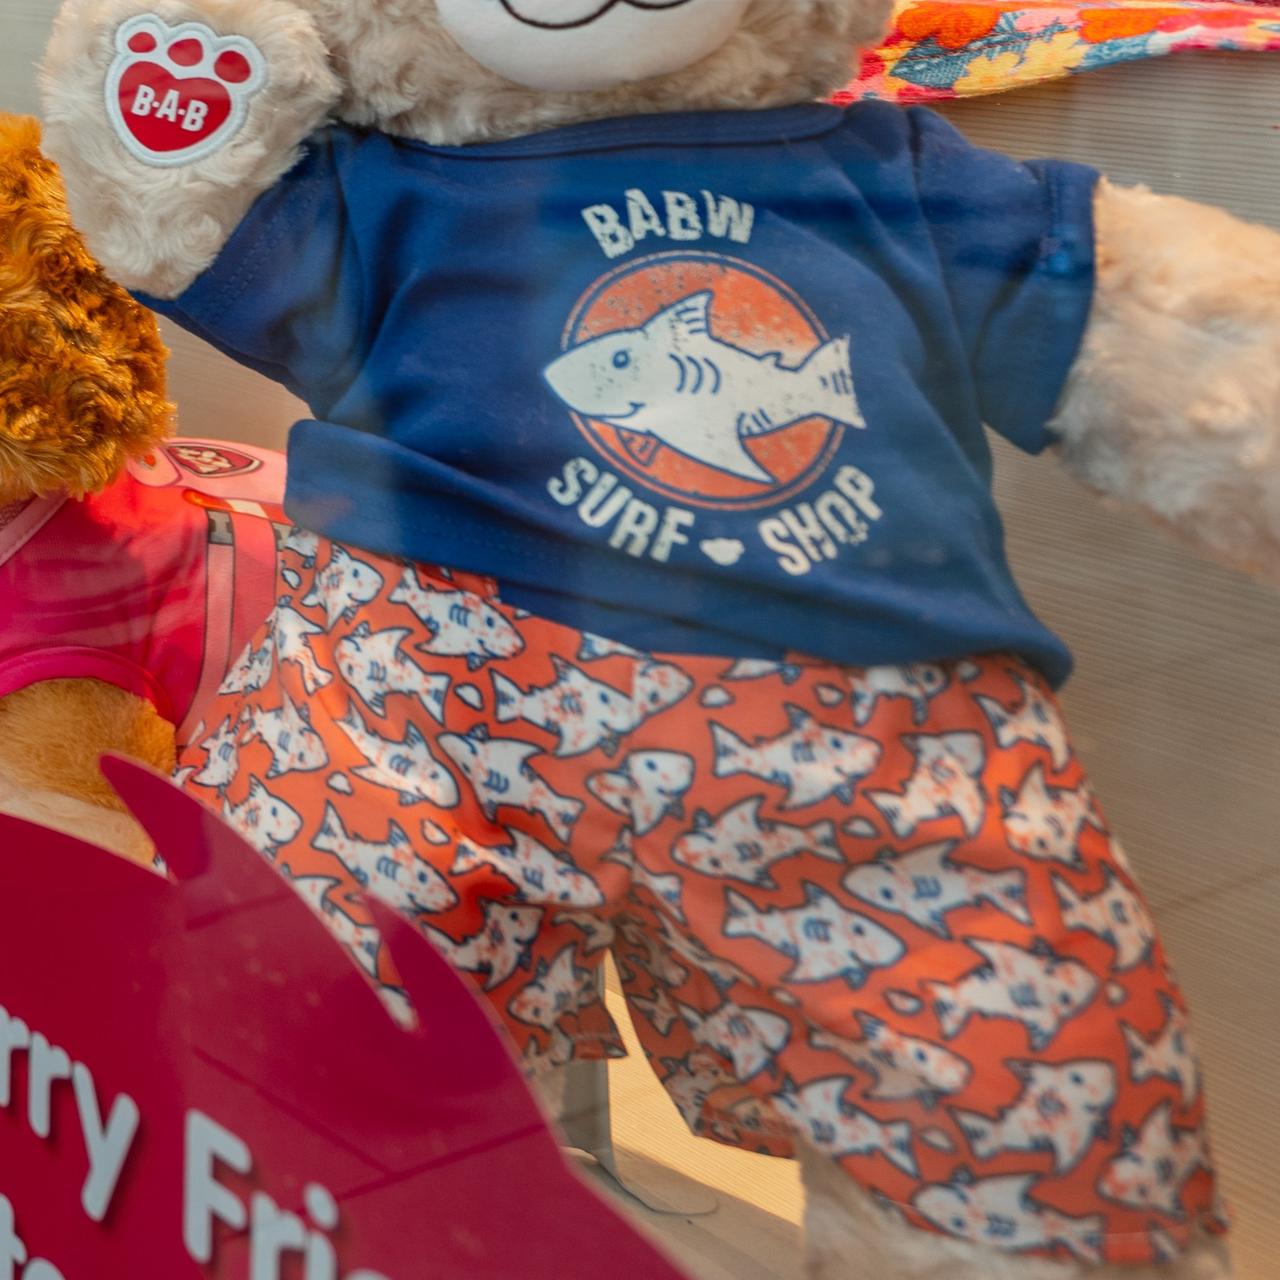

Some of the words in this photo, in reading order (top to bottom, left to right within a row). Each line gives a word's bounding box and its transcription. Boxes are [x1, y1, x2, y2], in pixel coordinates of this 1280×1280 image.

[581, 188, 754, 259] BABW
[546, 457, 695, 563] SURF
[757, 465, 883, 576] SHOP
[182, 1109, 388, 1280] Fri
